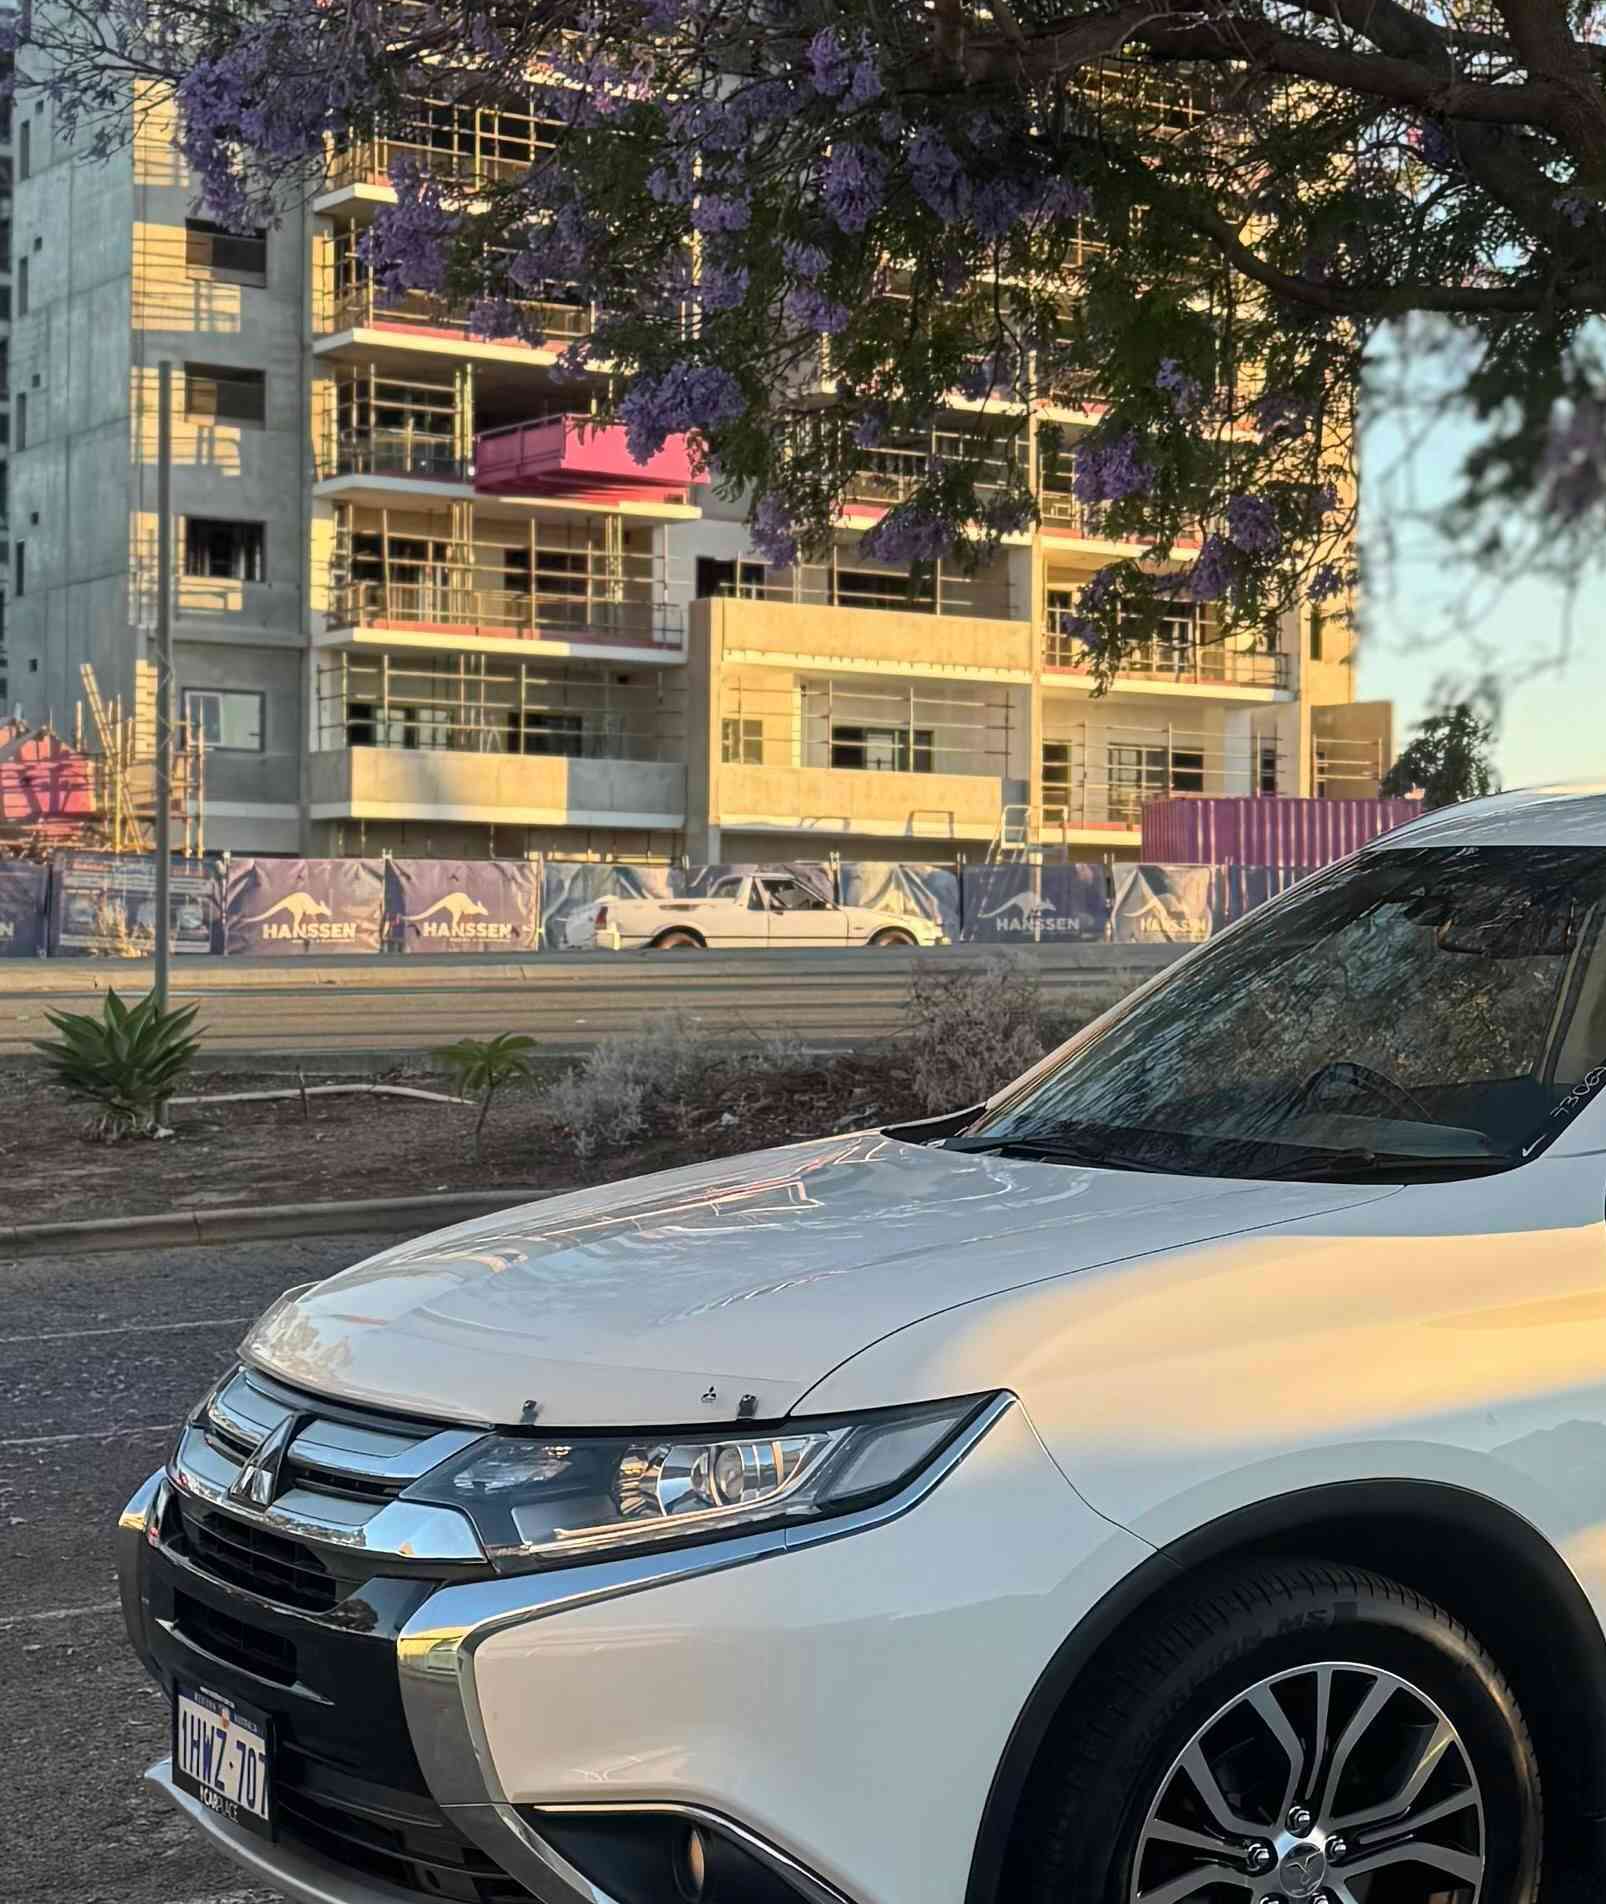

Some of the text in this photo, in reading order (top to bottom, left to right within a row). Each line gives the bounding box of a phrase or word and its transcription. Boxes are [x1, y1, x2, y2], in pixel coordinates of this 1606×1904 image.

[263, 923, 356, 939] HANSSEN
[423, 921, 512, 937] HANSSEN
[996, 917, 1080, 932] HANSSEN
